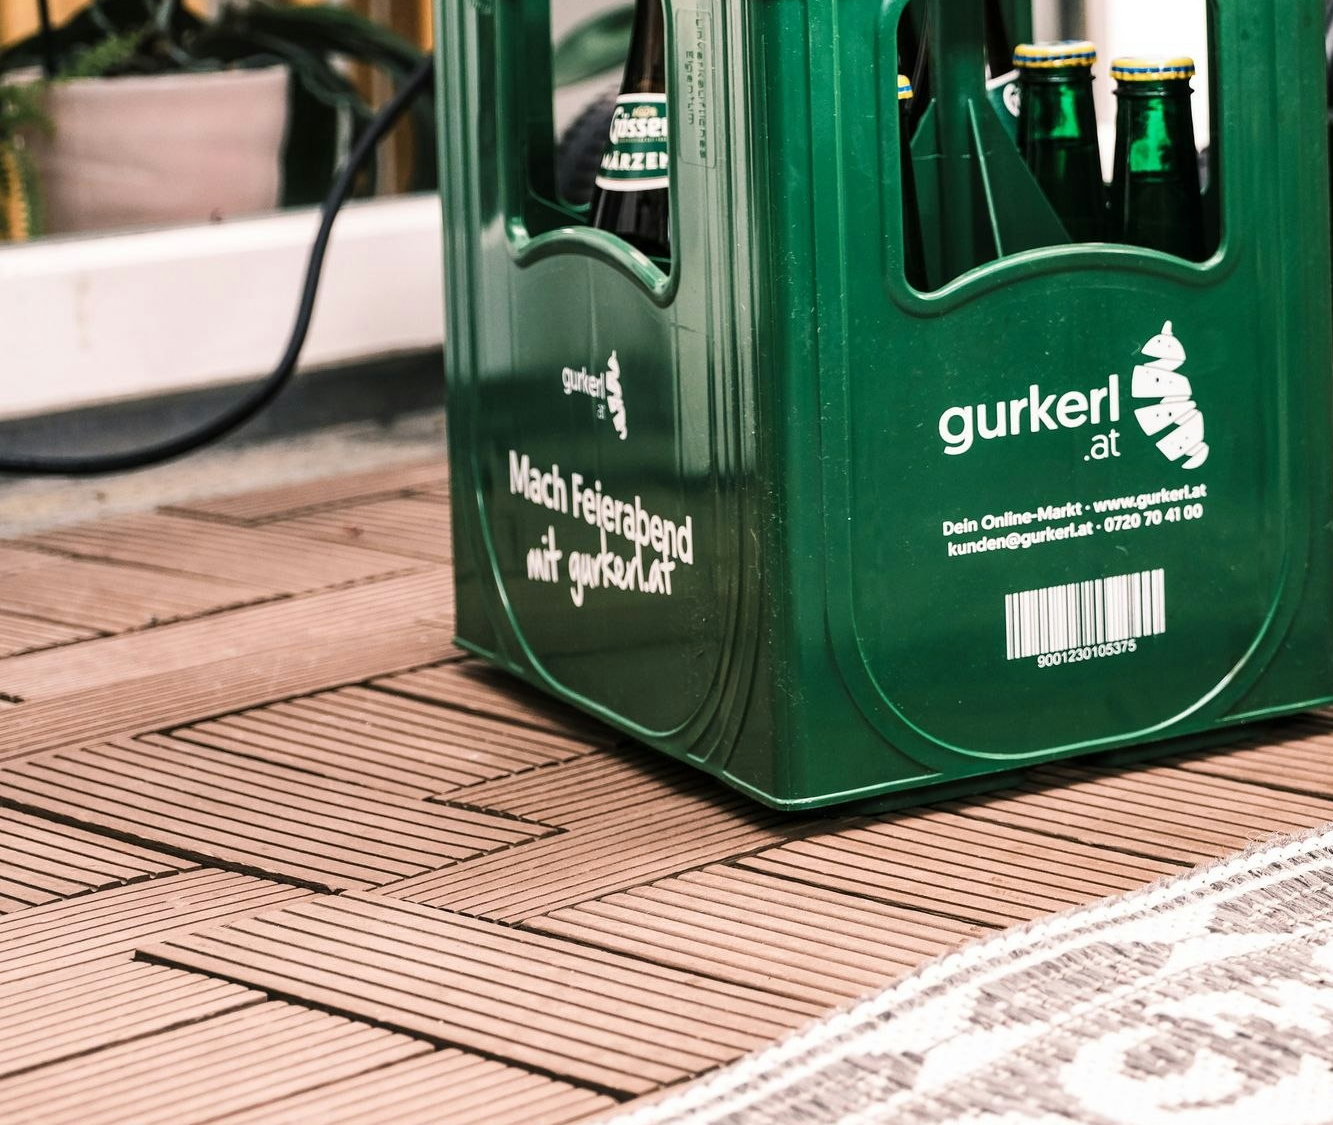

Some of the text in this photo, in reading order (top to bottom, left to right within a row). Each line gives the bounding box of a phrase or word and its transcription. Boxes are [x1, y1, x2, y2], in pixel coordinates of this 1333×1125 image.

[562, 366, 606, 400] gurkerl
[938, 373, 1120, 456] gurkerl
[1084, 428, 1121, 461] .at
[509, 449, 694, 565] Mach Feierabend
[942, 483, 1208, 537] Dein Online-Markt www.gurkerl.at
[948, 503, 1204, 557] kunden@gurkerl.at 0720 70 41 00
[527, 525, 677, 608] mit gurkerl.at
[1037, 638, 1137, 668] 9001230105375
